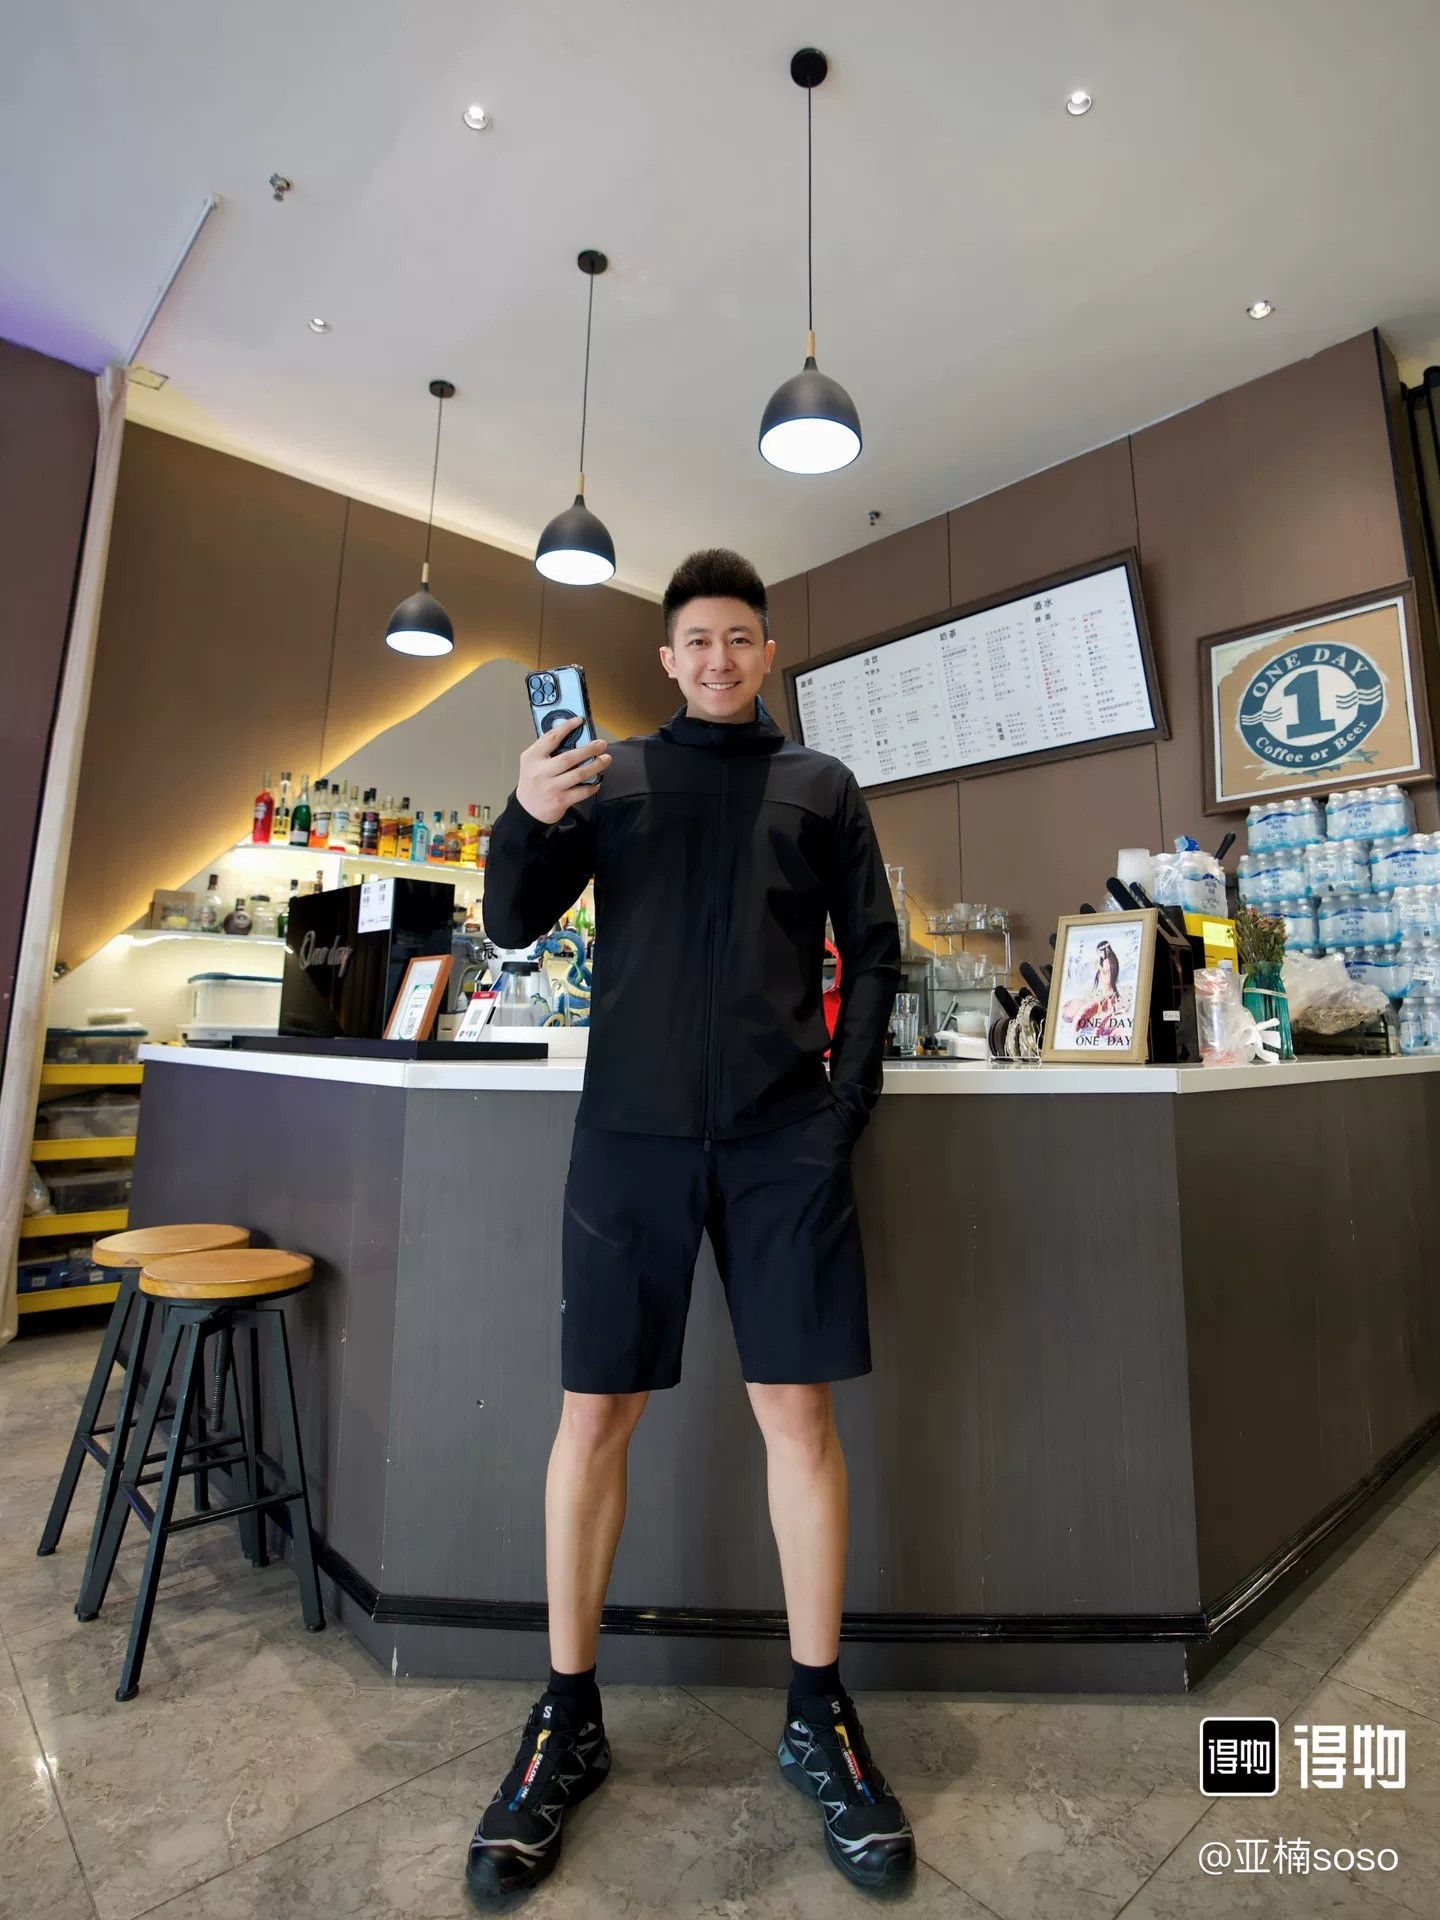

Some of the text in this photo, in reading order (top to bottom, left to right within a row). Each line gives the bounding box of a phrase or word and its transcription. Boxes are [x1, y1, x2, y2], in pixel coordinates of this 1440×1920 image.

[1253, 648, 1370, 698] ONE DAY
[1284, 670, 1336, 739] 1
[1256, 720, 1368, 763] Coffee or Beer
[1076, 1036, 1130, 1046] ONE DAY
[1078, 1018, 1132, 1028] ONE DAY
